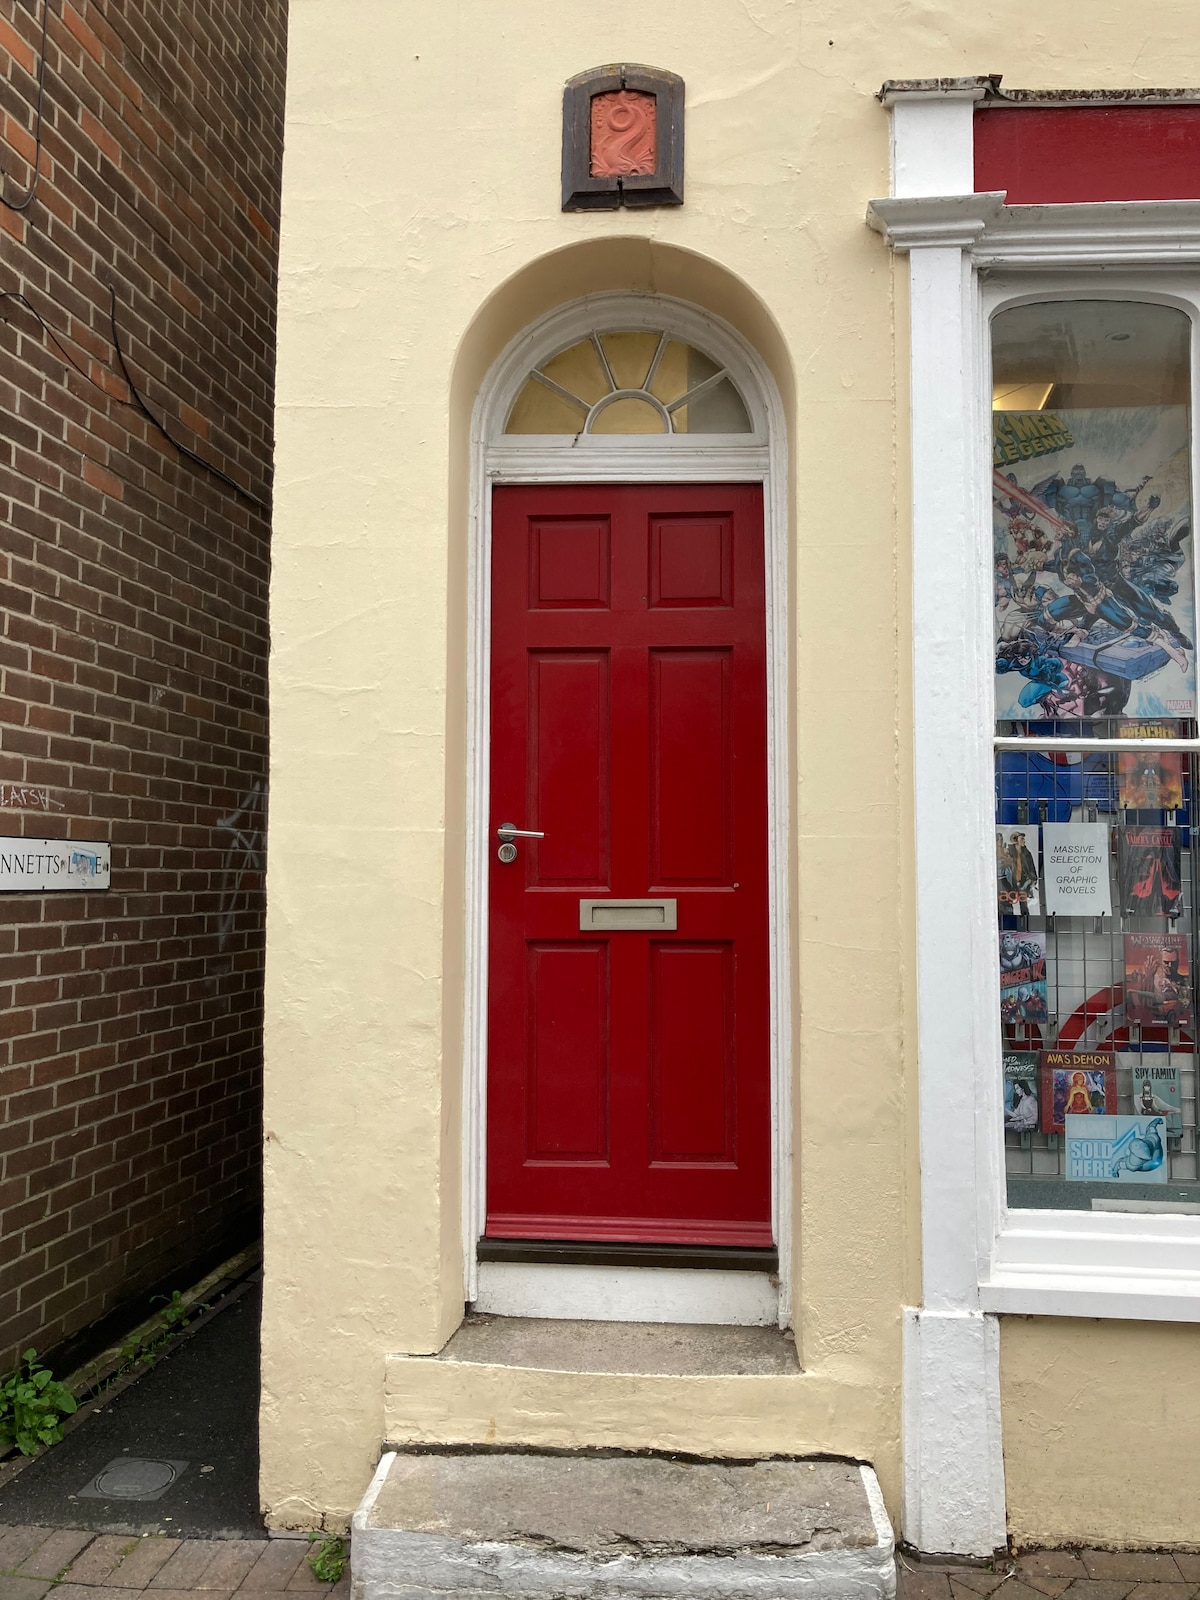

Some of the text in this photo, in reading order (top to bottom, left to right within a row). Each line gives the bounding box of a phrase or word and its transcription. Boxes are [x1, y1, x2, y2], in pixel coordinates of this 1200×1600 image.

[993, 433, 1075, 466] LEGENDS
[1167, 700, 1192, 710] MARVEL
[1053, 845, 1095, 854] MASSIVE
[68, 855, 102, 874] LE
[1050, 855, 1102, 864] SELECTION
[1070, 866, 1083, 874] OF
[1056, 876, 1098, 884] GRAPHIC
[1058, 886, 1096, 894] NOVELS
[1047, 1053, 1110, 1065] AVA'S DEMON
[1070, 1141, 1113, 1160] SOLD
[1071, 1159, 1113, 1178] HERE
